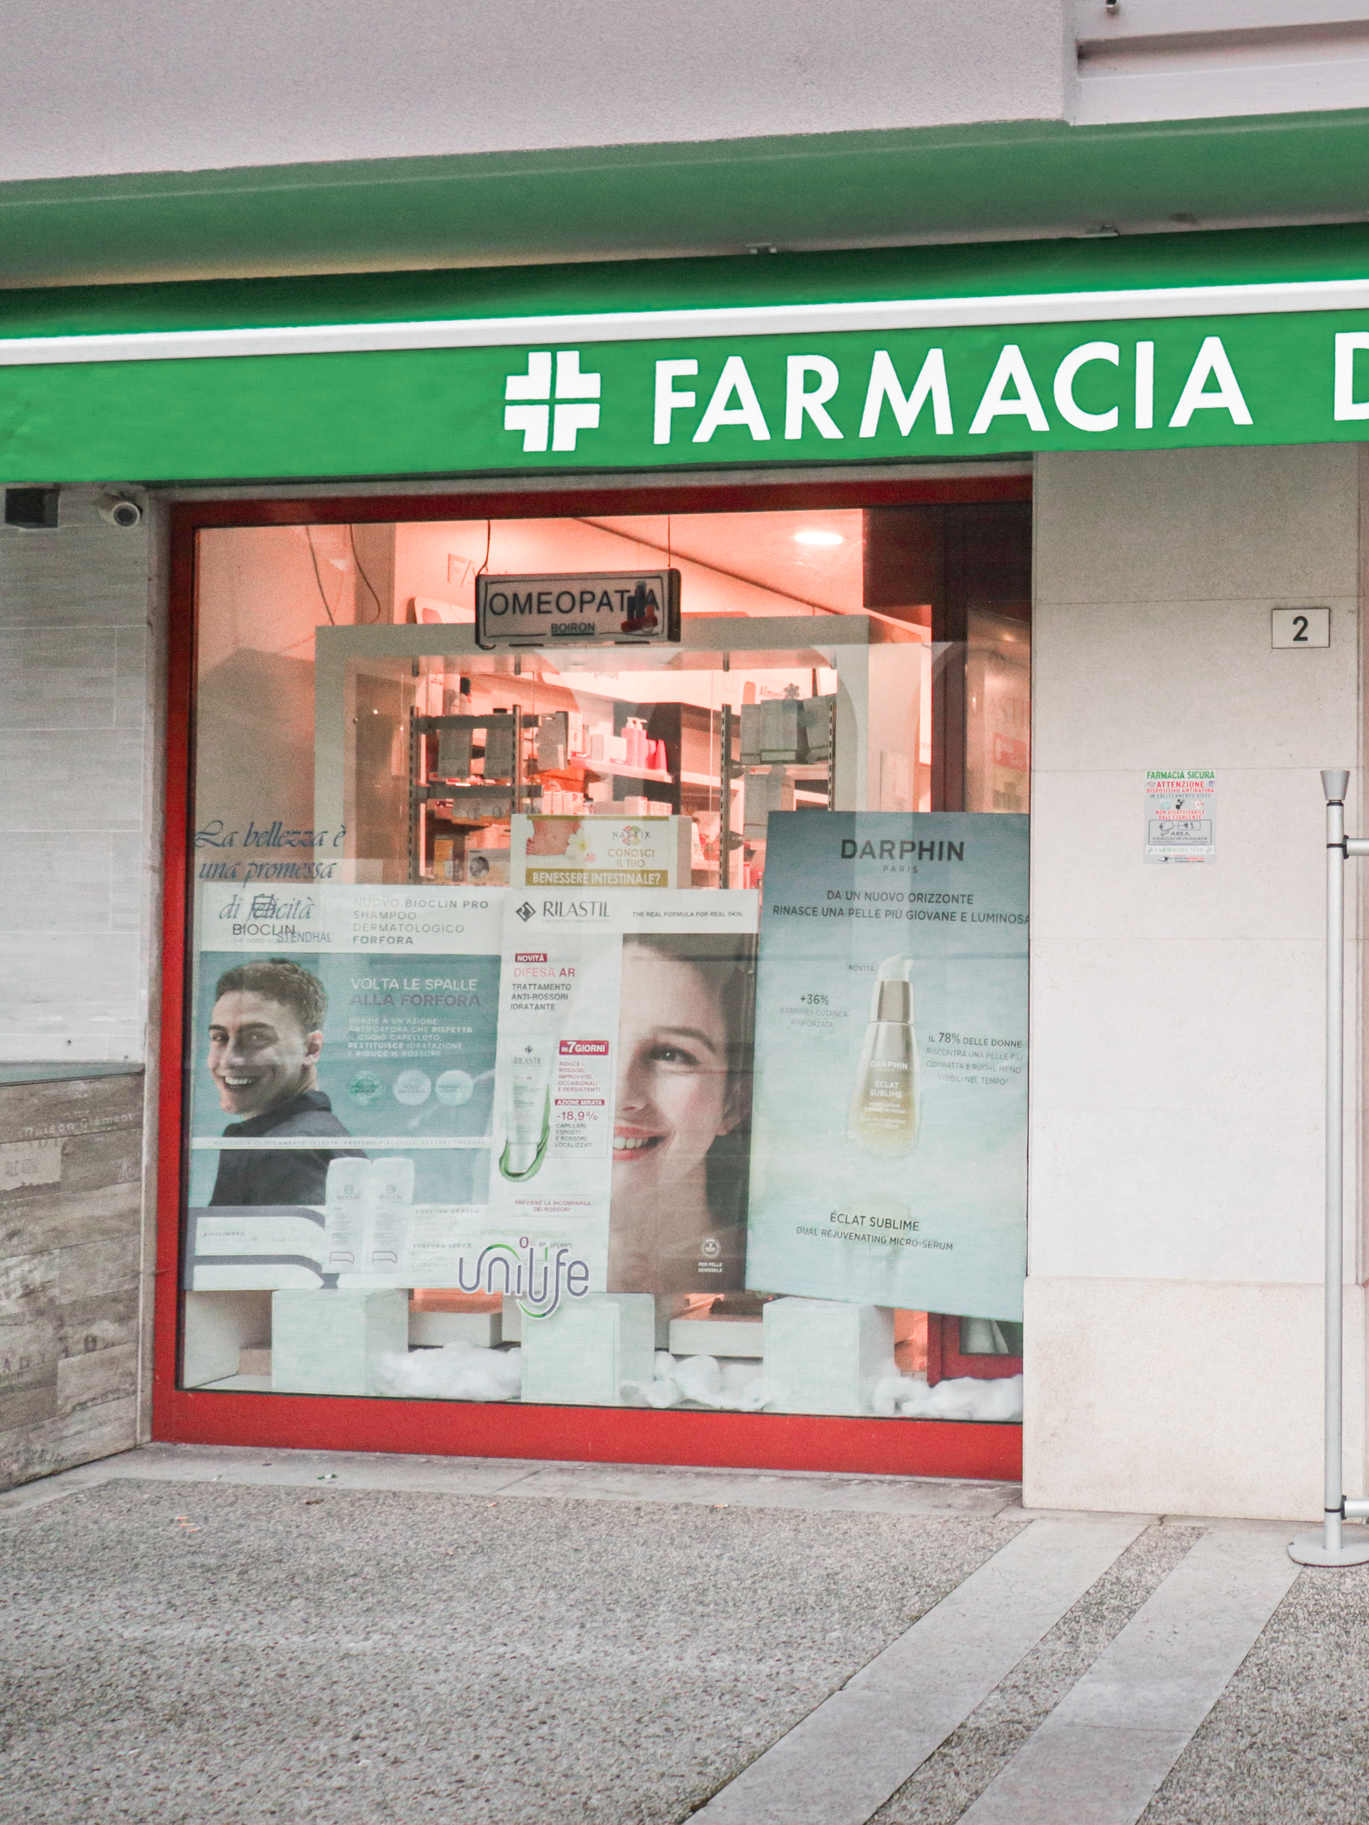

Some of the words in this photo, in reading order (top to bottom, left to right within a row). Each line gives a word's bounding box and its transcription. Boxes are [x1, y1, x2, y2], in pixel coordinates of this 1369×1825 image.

[652, 335, 1254, 446] FARMACIA
[489, 589, 661, 617] OMEOPATA
[551, 622, 596, 633] BOIRON
[1292, 615, 1309, 642] 2
[242, 820, 329, 848] bellezza
[840, 838, 966, 862] DARPHIN
[199, 861, 242, 880] una
[242, 861, 337, 888] promessa
[882, 864, 919, 874] PARIS
[531, 871, 590, 885] BENESSERE
[591, 872, 662, 886] INTESTINALE?
[404, 898, 458, 909] BIOCLIN
[462, 900, 490, 909] PRO
[826, 890, 842, 901] DA
[845, 891, 861, 901] UN
[864, 892, 905, 904] NUOVO
[908, 892, 974, 905] ORIZZONTE
[353, 910, 417, 921] SHAMPOO
[542, 900, 612, 918] RILASTIL
[772, 904, 819, 917] RINASCE
[821, 906, 845, 918] UNA
[848, 907, 881, 920] PELLE
[905, 910, 957, 922] GIOVANE
[960, 911, 968, 922] E
[231, 923, 297, 936] BIOCLIN
[352, 922, 466, 934] DERMATOLOGICO
[352, 935, 415, 945] FORFORA
[350, 977, 400, 991] VOLTA
[402, 977, 420, 991] LE
[424, 978, 479, 992] SPALLE
[511, 983, 573, 991] TRATTAMENTO
[400, 994, 481, 1007] FORFORA
[510, 1003, 556, 1011] IDRATANTE
[575, 1043, 606, 1053] GIORNI
[962, 1036, 989, 1047] DELLE
[991, 1038, 1023, 1049] DONNE
[829, 1209, 867, 1227] ÉCLAT
[869, 1216, 920, 1232] SUBLIME
[458, 1243, 590, 1319] unilife
